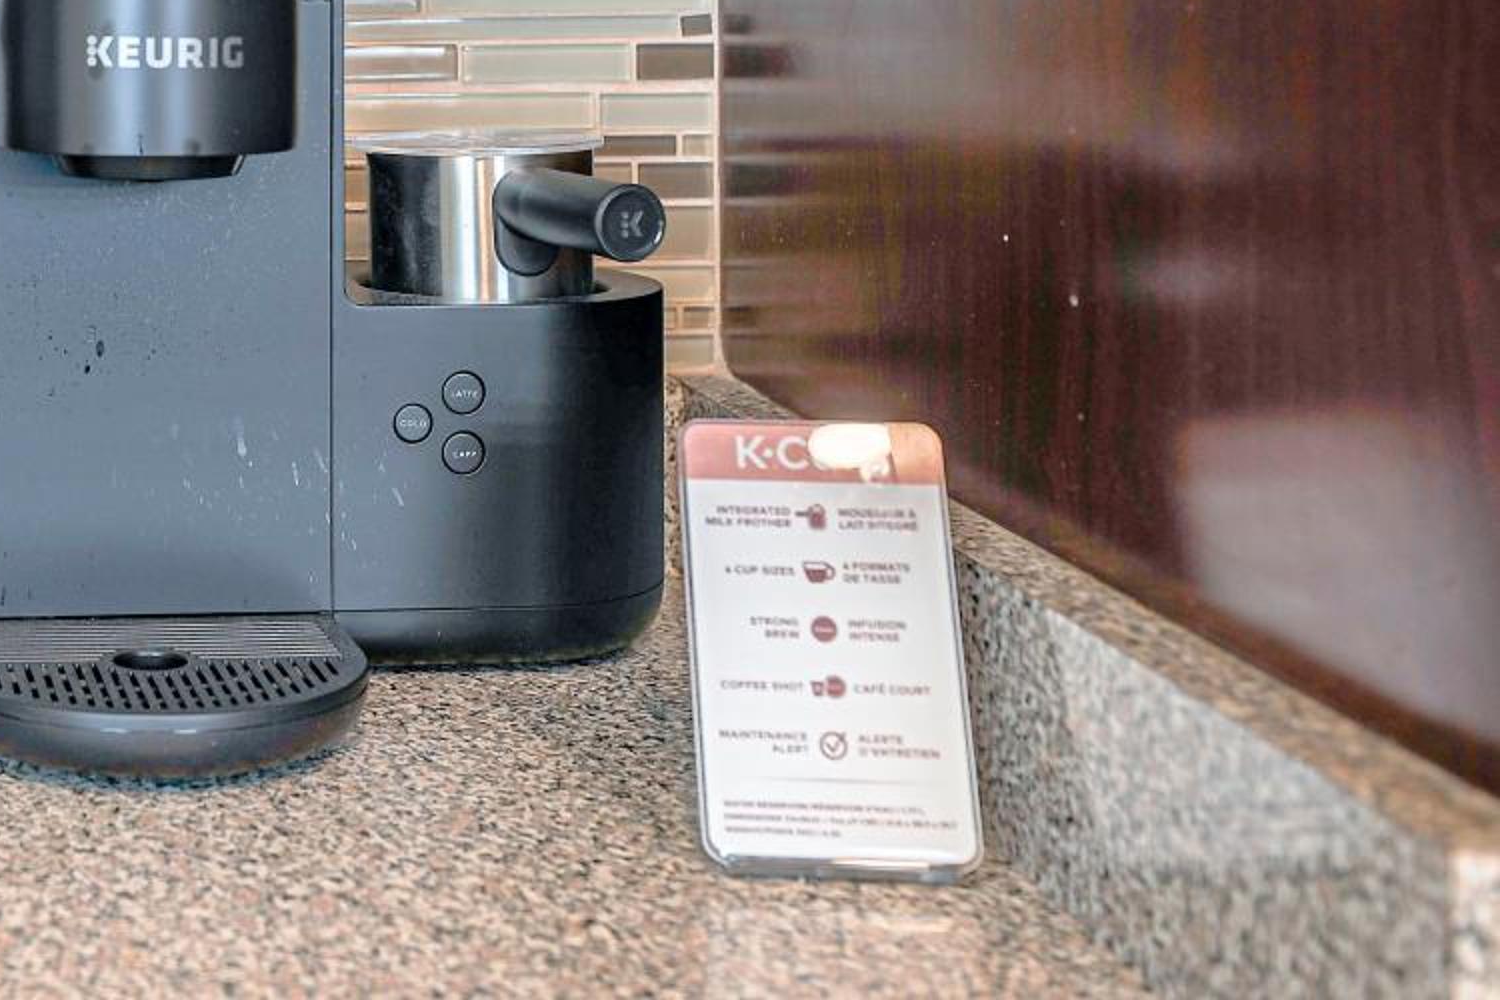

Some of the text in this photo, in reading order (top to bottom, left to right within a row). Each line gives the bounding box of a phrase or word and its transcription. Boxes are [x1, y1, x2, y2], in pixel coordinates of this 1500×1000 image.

[86, 34, 244, 69] KEURIG
[734, 565, 759, 575] CUP
[762, 566, 795, 577] SIZES
[750, 616, 799, 627] STRONG
[847, 620, 907, 631] INFUSION
[720, 679, 767, 691] COFFEE
[718, 729, 808, 742] MAINTENANCE
